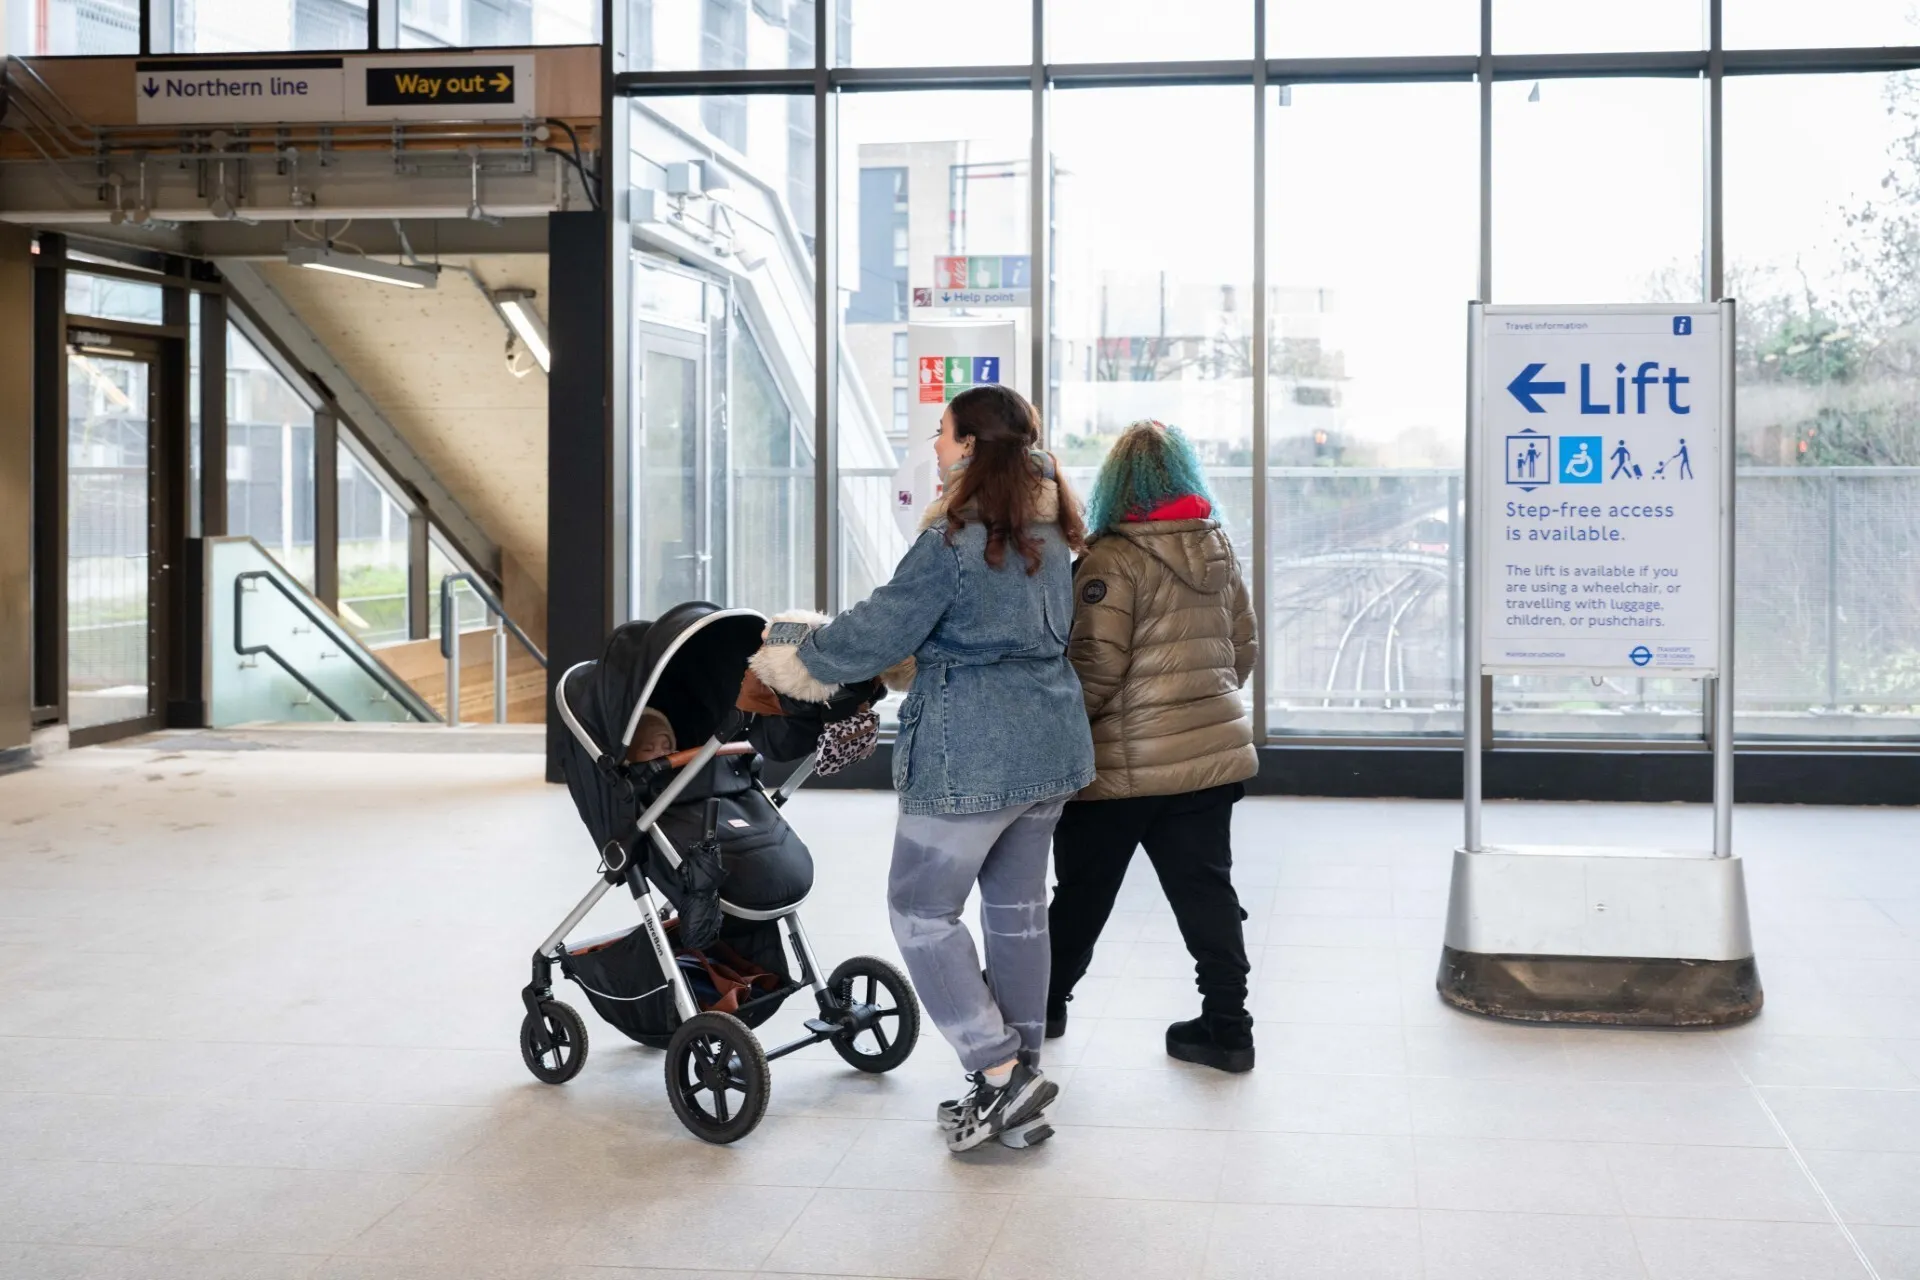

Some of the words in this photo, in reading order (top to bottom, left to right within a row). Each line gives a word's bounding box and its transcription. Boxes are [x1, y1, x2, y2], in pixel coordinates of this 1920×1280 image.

[166, 79, 262, 98] Northern
[271, 78, 308, 96] line
[395, 75, 441, 98] Way
[447, 75, 485, 93] out
[954, 292, 981, 303] Help
[984, 292, 1015, 303] point
[1505, 322, 1533, 331] Travel
[1535, 322, 1588, 331] information
[1580, 361, 1690, 415] Lift
[1506, 501, 1601, 520] Step-free
[1608, 506, 1674, 518] access
[1506, 526, 1522, 541] is
[1529, 526, 1626, 542] available.
[1506, 565, 1531, 577] The
[1535, 565, 1556, 577] lift
[1560, 565, 1570, 577] is
[1574, 565, 1635, 577] available
[1639, 565, 1649, 577] if
[1653, 568, 1678, 580] you
[1506, 584, 1527, 593] are
[1531, 582, 1568, 597] using
[1571, 584, 1579, 593] a
[1582, 581, 1663, 594] wheelchair,
[1667, 584, 1681, 593] or
[1506, 598, 1571, 613] travelling
[1575, 598, 1606, 610] with
[1610, 598, 1664, 613] luggage,
[1506, 614, 1565, 627] children,
[1571, 617, 1584, 626] or
[1589, 614, 1665, 629] pushchairs.
[644, 913, 664, 957] LibreBon
